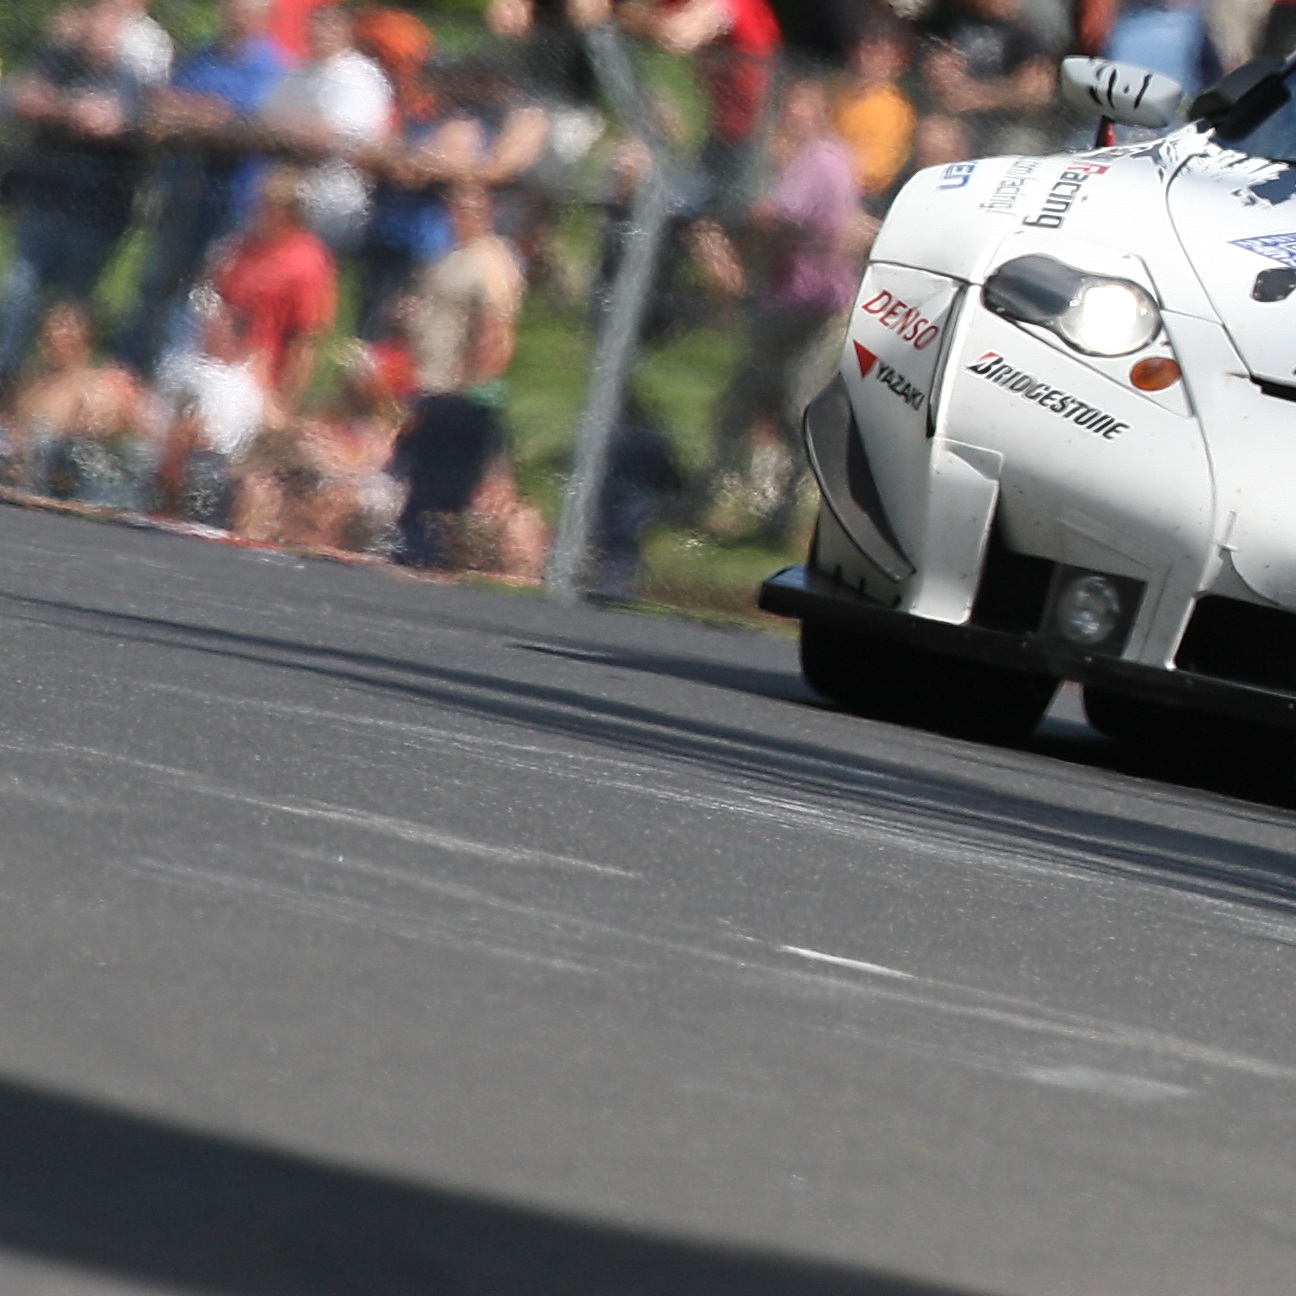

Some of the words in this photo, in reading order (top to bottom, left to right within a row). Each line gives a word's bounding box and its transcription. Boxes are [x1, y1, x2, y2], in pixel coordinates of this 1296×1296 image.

[861, 289, 941, 352] DENSO
[875, 361, 926, 411] YAZAKI
[967, 351, 1131, 442] BRIDGESTONE
